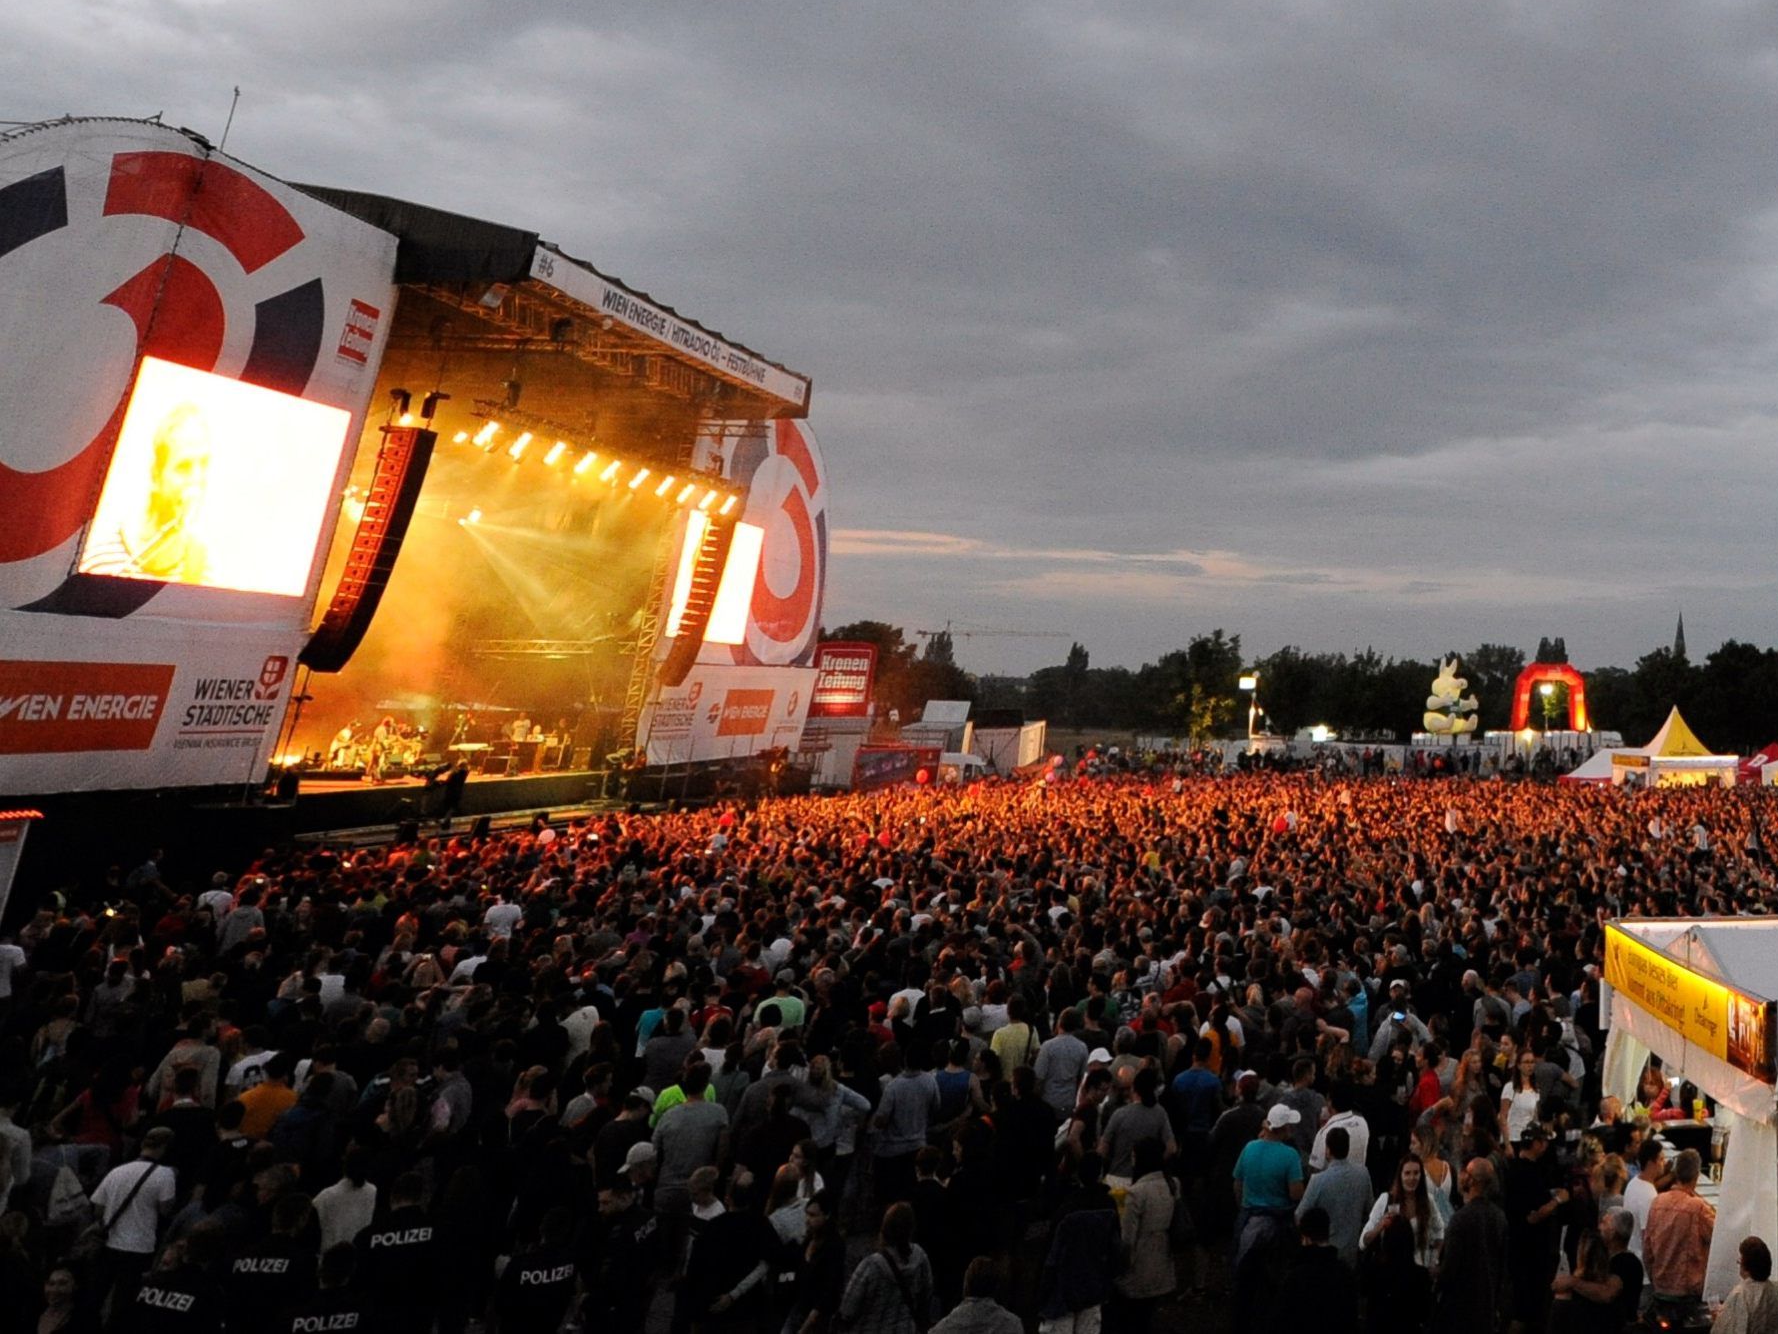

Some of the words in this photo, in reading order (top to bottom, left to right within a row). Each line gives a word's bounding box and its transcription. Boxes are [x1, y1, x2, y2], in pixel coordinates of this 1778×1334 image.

[602, 288, 629, 318] WIEN
[628, 303, 667, 335] ENERGIE
[671, 324, 711, 358] HITRADIO
[821, 654, 869, 671] Kronen
[194, 678, 255, 701] WIENER
[818, 671, 866, 689] Zeitung
[0, 694, 63, 721] WIEN
[67, 694, 158, 720] ENERGIE
[182, 703, 275, 726] STÄDTISCHE
[370, 1227, 432, 1249] POLIZEI
[232, 1258, 289, 1274] POLIZEI
[520, 1264, 574, 1285] POLIZEI
[136, 1286, 195, 1312] POLIZEI
[292, 1312, 359, 1334] POLIZEI
